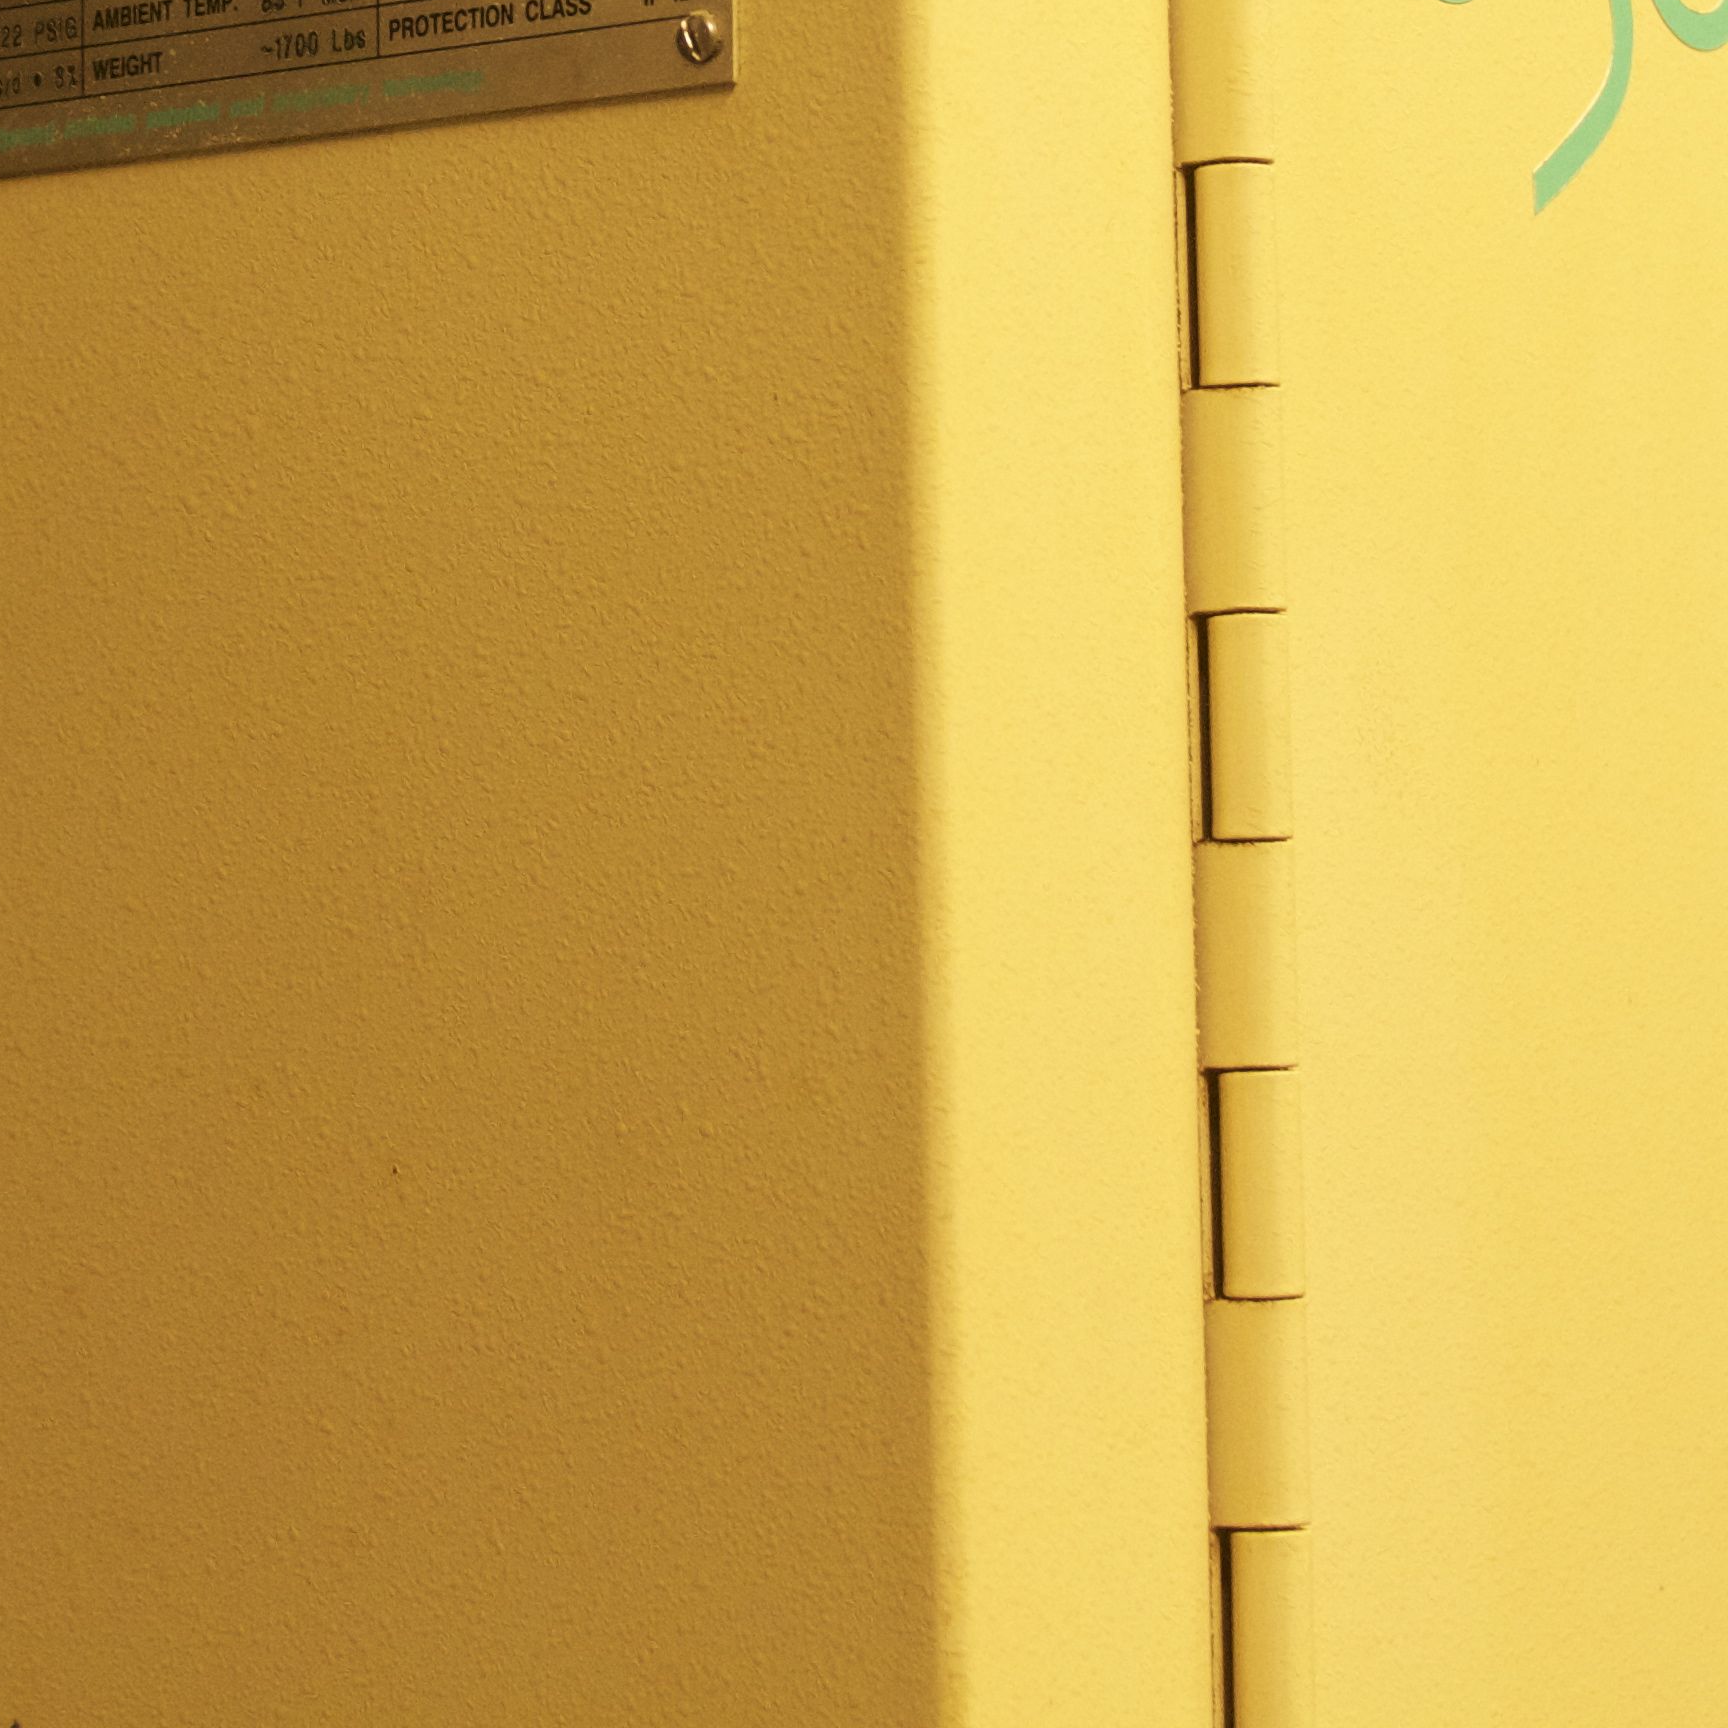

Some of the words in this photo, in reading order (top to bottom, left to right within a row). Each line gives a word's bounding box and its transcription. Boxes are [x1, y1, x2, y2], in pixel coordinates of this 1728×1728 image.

[1, 24, 22, 49] 22
[34, 16, 78, 45] PSIG
[92, 0, 173, 31] AMBIENT
[388, 3, 514, 41] PROTECTION
[92, 51, 163, 81] WEIGHT
[331, 27, 367, 53] Lbs
